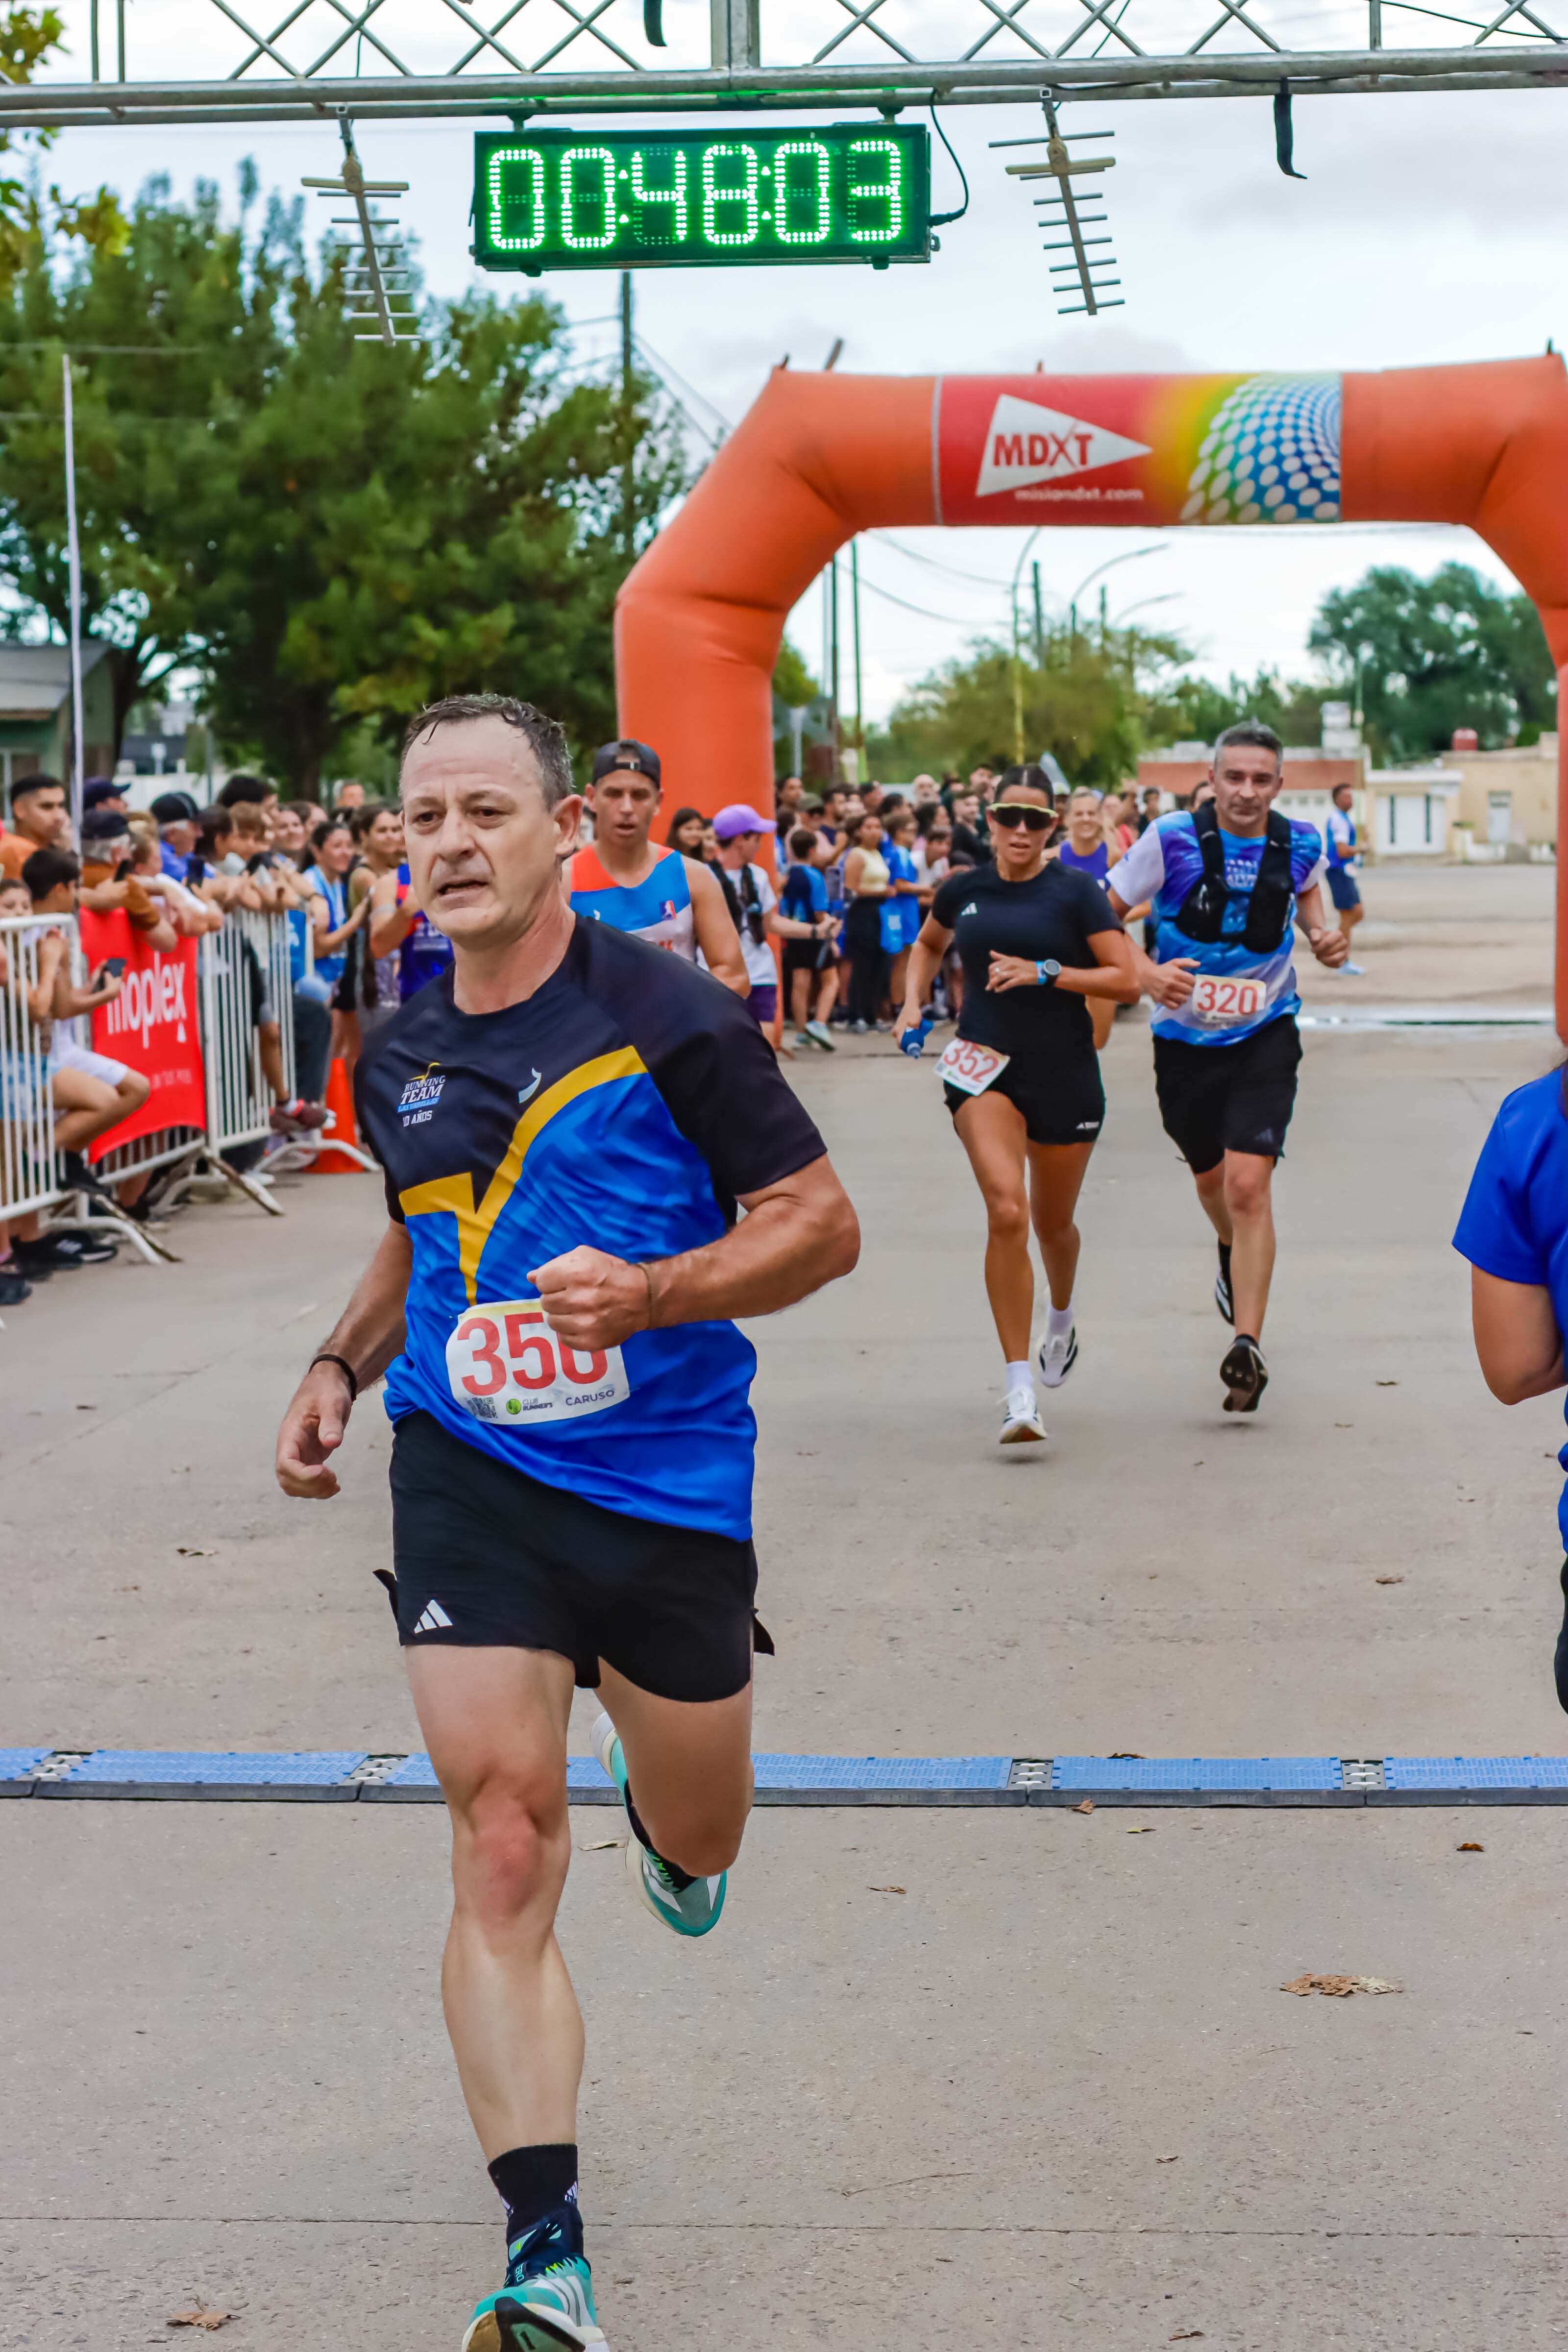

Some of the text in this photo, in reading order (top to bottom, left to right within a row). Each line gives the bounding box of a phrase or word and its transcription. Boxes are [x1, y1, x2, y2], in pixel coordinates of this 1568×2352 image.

[490, 140, 901, 248] 00:48:03
[994, 434, 1093, 467] MDXT
[1197, 980, 1258, 1016] 320
[943, 1039, 999, 1083] 352
[400, 1084, 444, 1105] TEAM
[404, 1076, 446, 1092] RUNNING
[403, 1110, 433, 1127] 10 AÑOS
[565, 1390, 615, 1406] CARUSO
